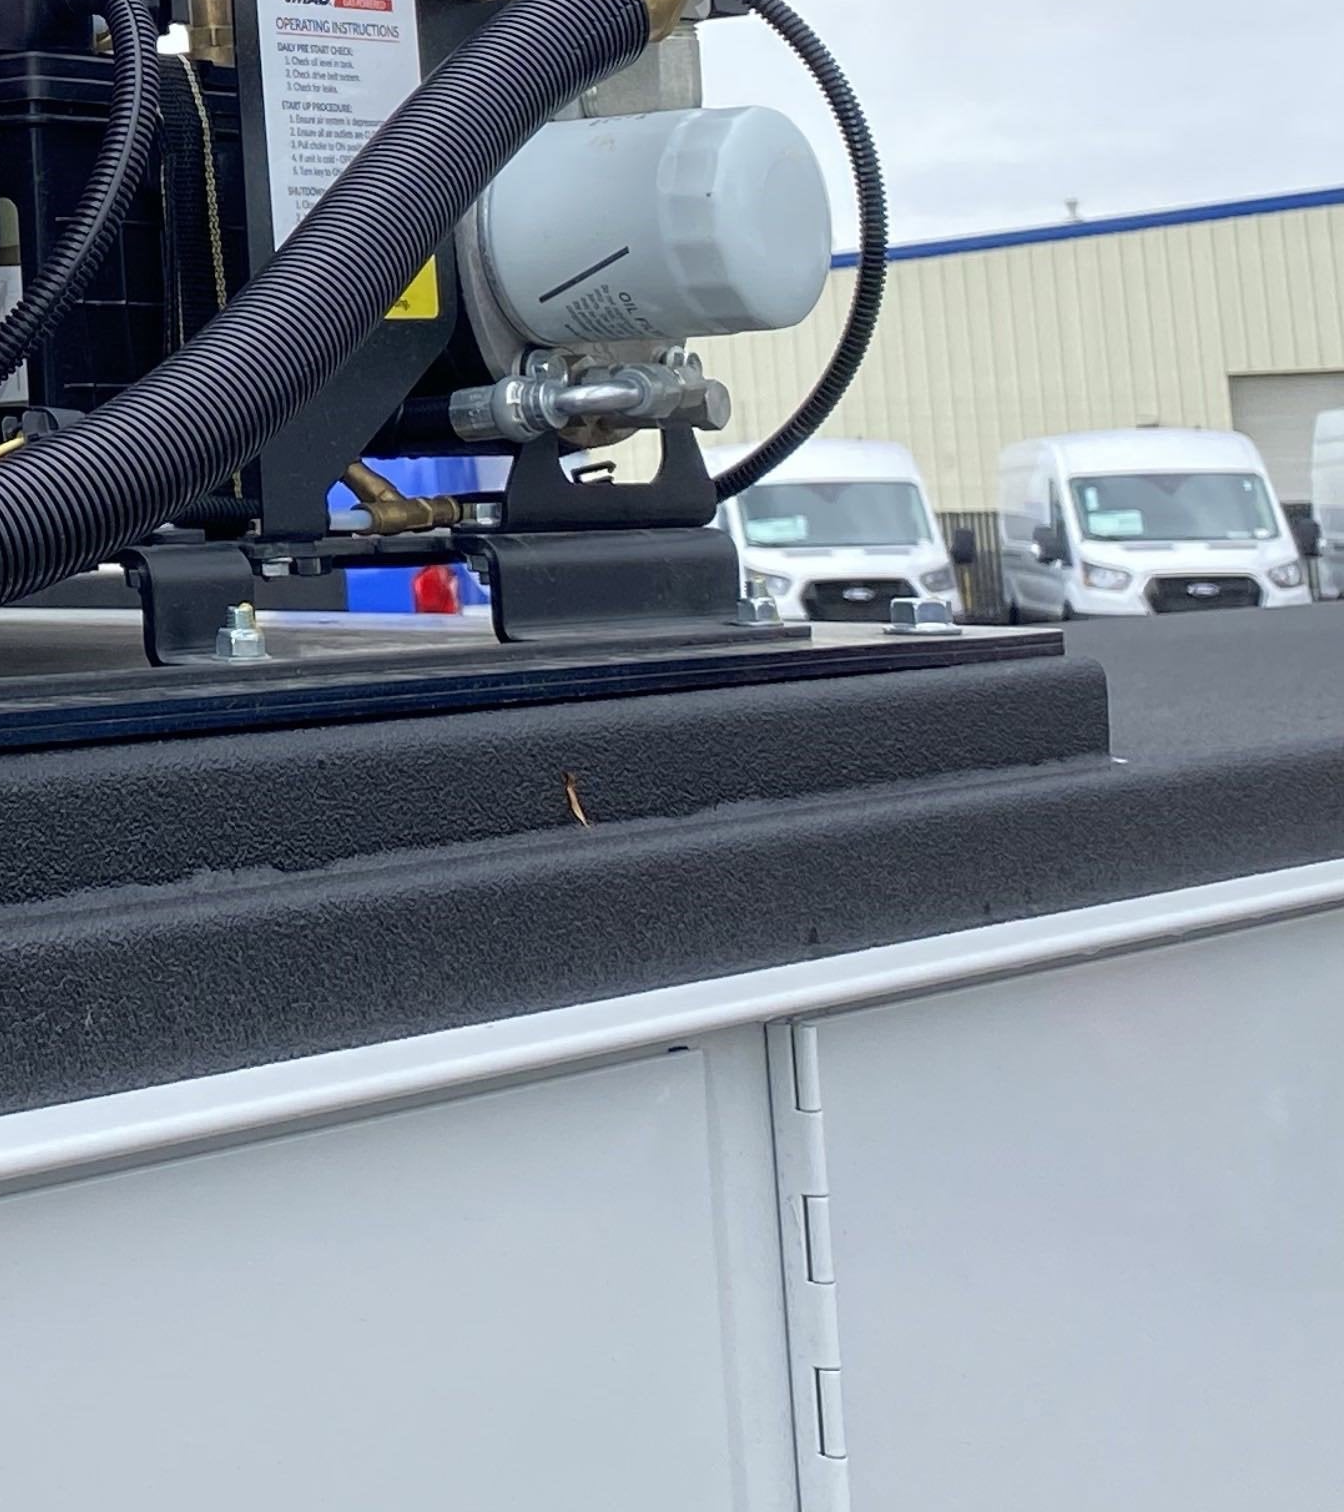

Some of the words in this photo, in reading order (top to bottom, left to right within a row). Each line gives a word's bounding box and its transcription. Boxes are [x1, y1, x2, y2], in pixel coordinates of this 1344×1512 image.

[276, 17, 330, 33] OPERATING
[332, 22, 399, 38] INSTRUCTIONS
[618, 291, 639, 315] OIL
